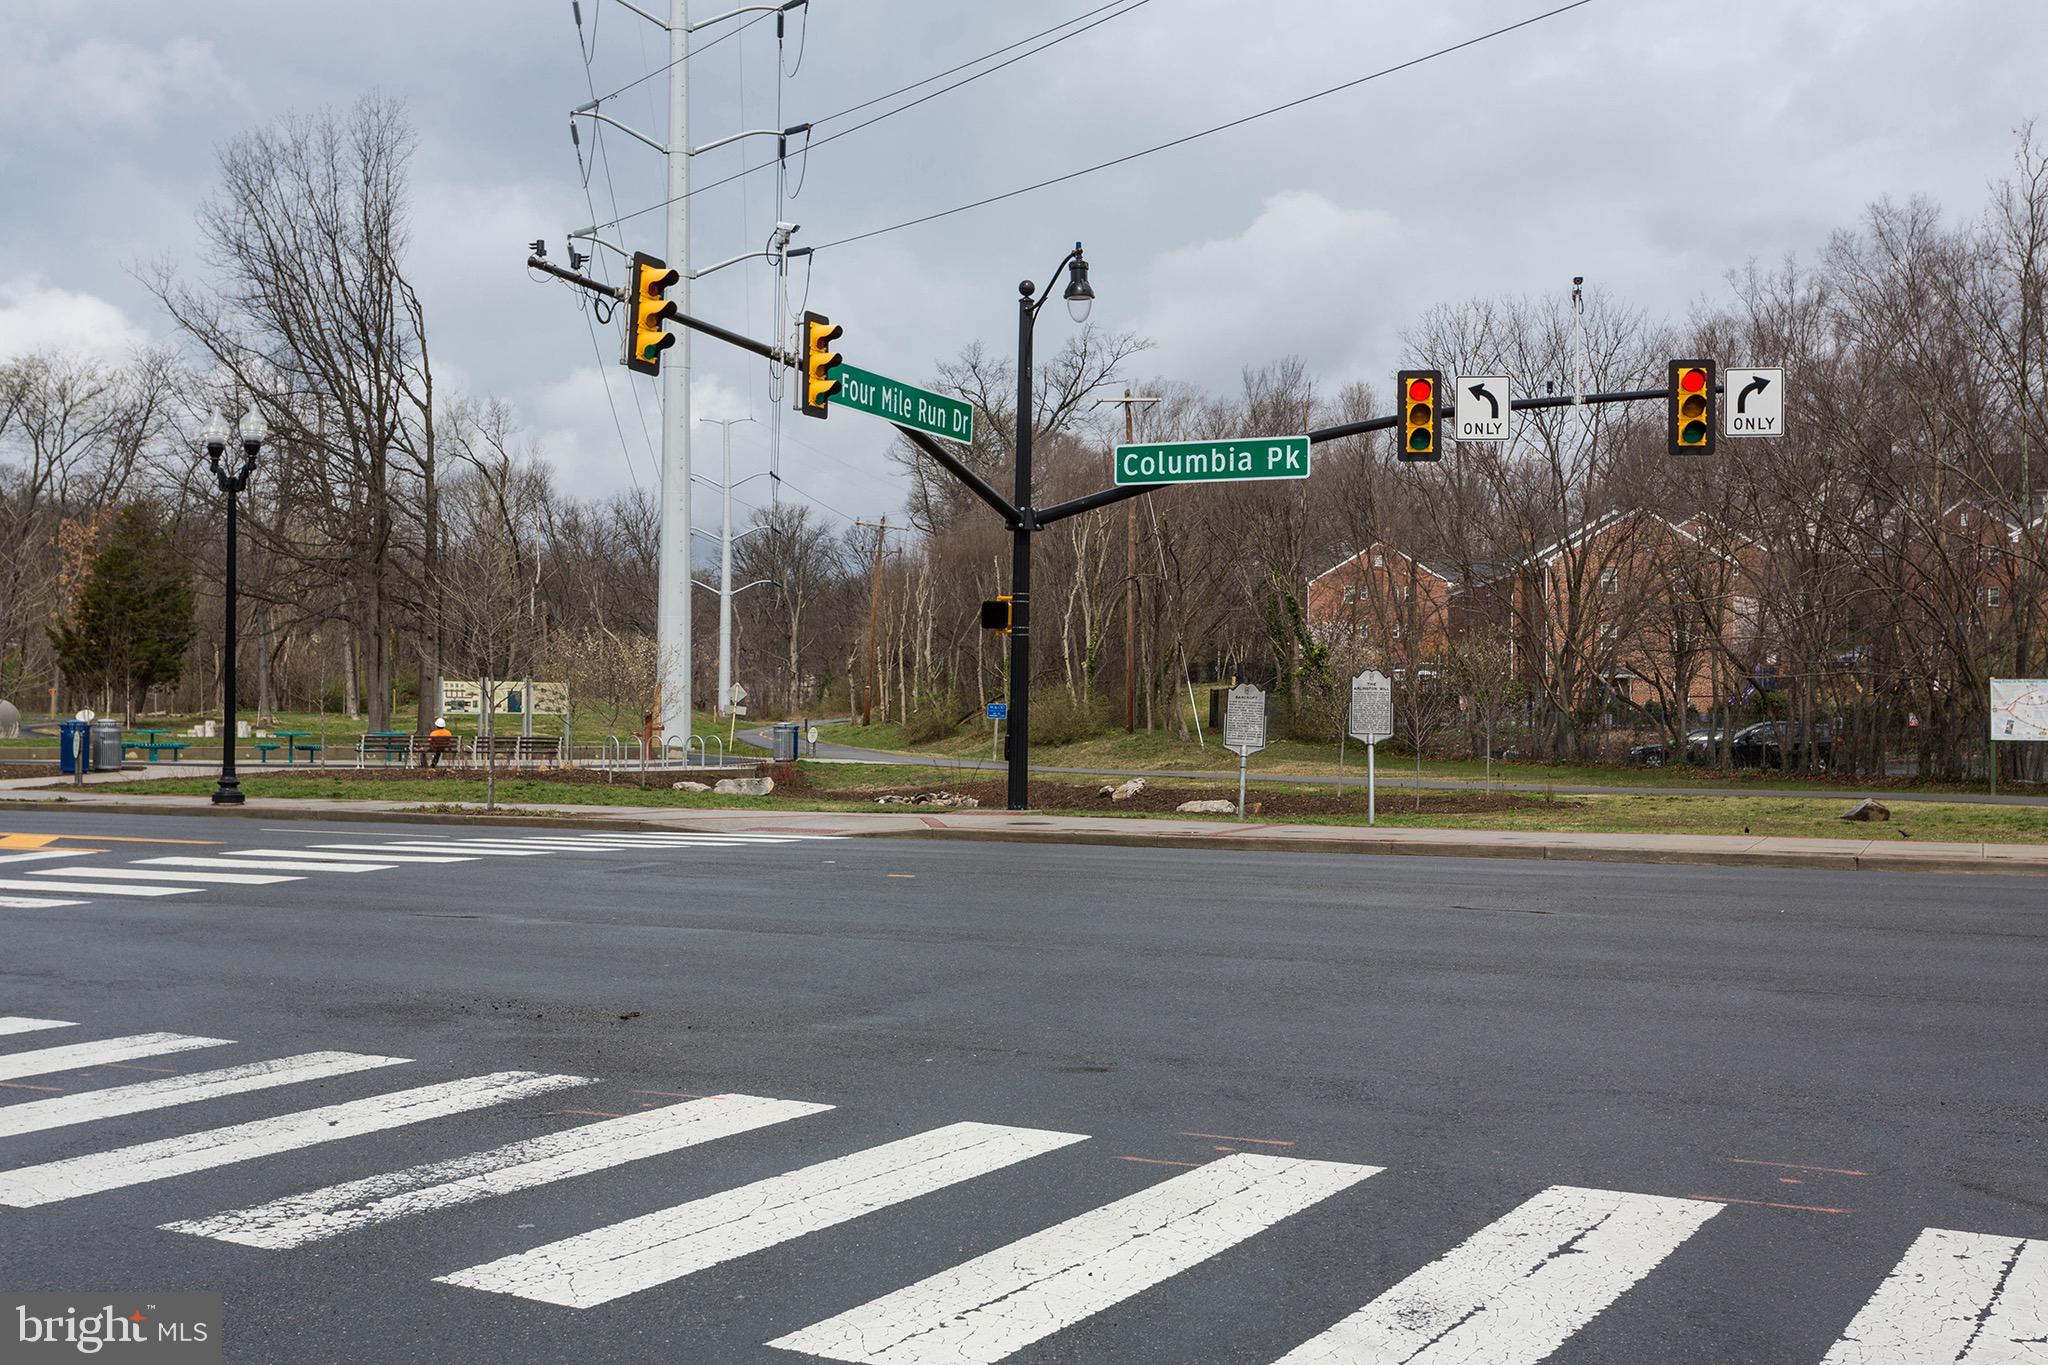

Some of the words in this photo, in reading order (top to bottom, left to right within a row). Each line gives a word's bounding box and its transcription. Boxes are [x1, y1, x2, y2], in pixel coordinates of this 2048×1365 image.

[841, 373, 875, 406] Four
[881, 386, 912, 418] Mile
[918, 398, 946, 428] Run
[953, 409, 968, 434] Dr
[1464, 422, 1502, 435] ONLY
[1733, 417, 1775, 430] ONLY
[1123, 446, 1252, 476] Columbia
[1268, 445, 1300, 470] Pk
